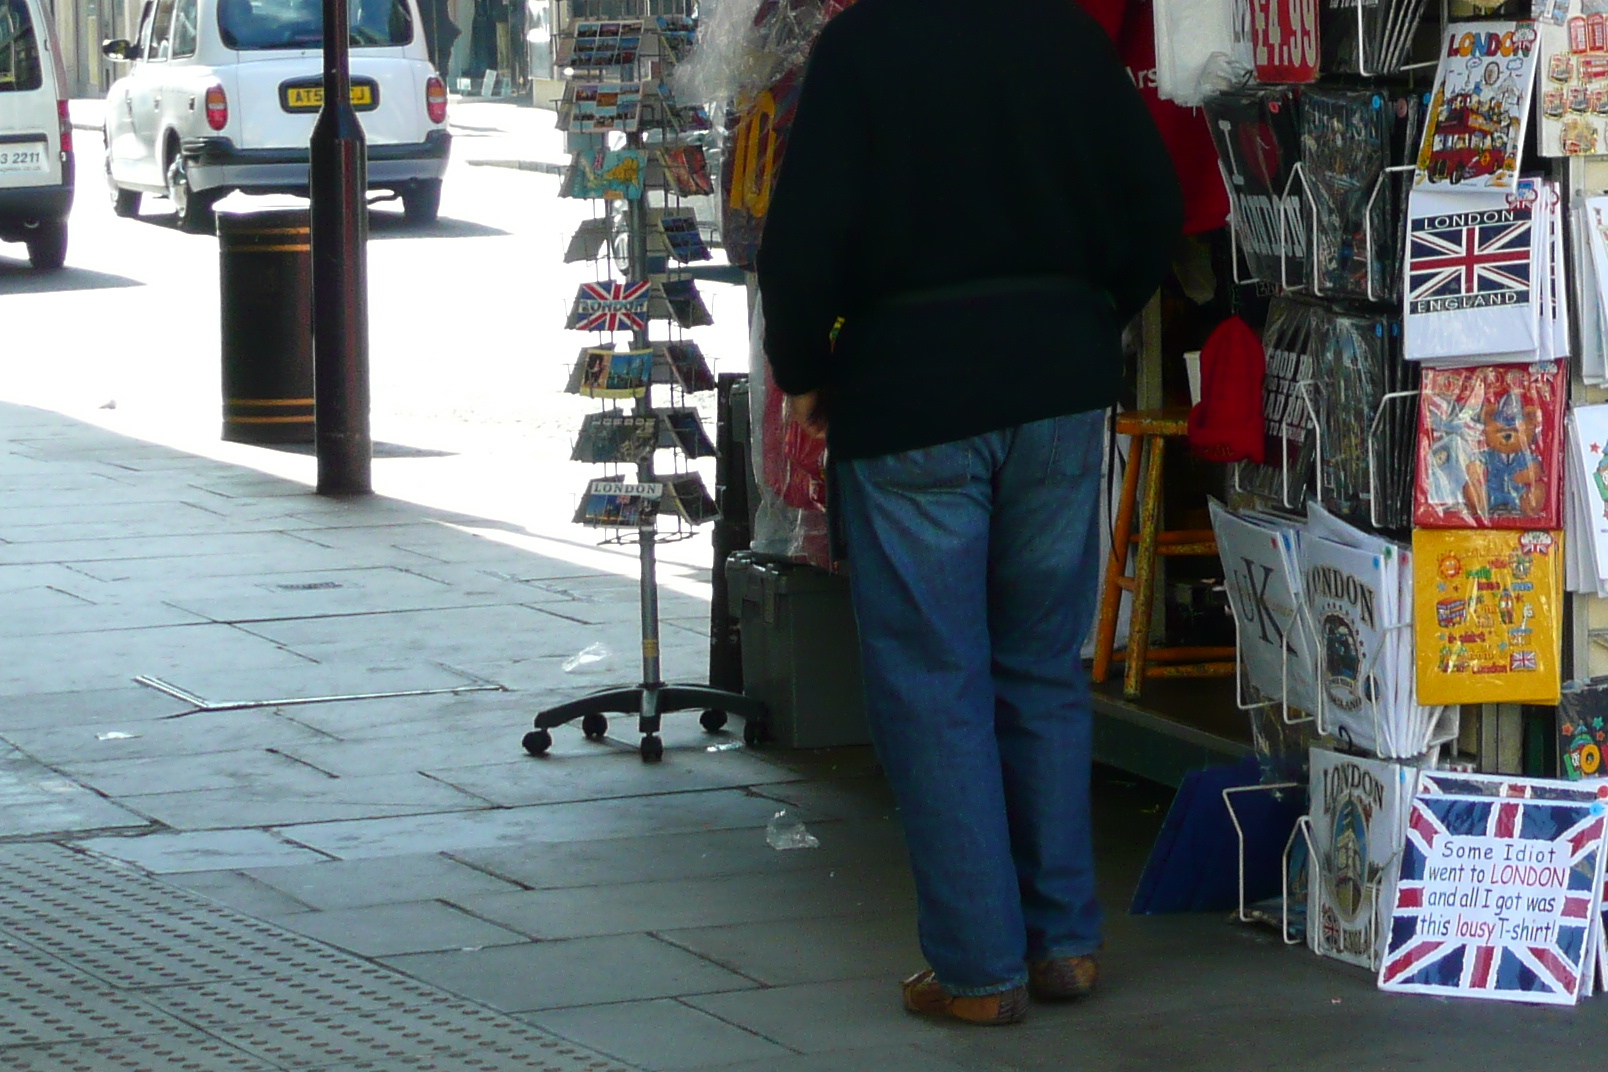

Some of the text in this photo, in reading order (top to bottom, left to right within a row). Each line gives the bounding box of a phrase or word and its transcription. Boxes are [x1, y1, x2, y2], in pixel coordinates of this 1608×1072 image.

[12, 152, 40, 164] 2211
[1423, 209, 1515, 229] LONDON
[1416, 291, 1519, 313] ENGLAND
[592, 482, 658, 496] LONDON
[1306, 562, 1377, 632] LONDON
[1321, 764, 1386, 812] LONDON
[1440, 840, 1557, 864] Some Idiot
[1428, 863, 1567, 888] went to LONDON
[1427, 886, 1556, 917] and all I got was
[1418, 914, 1557, 946] this lousy T-shirt!
